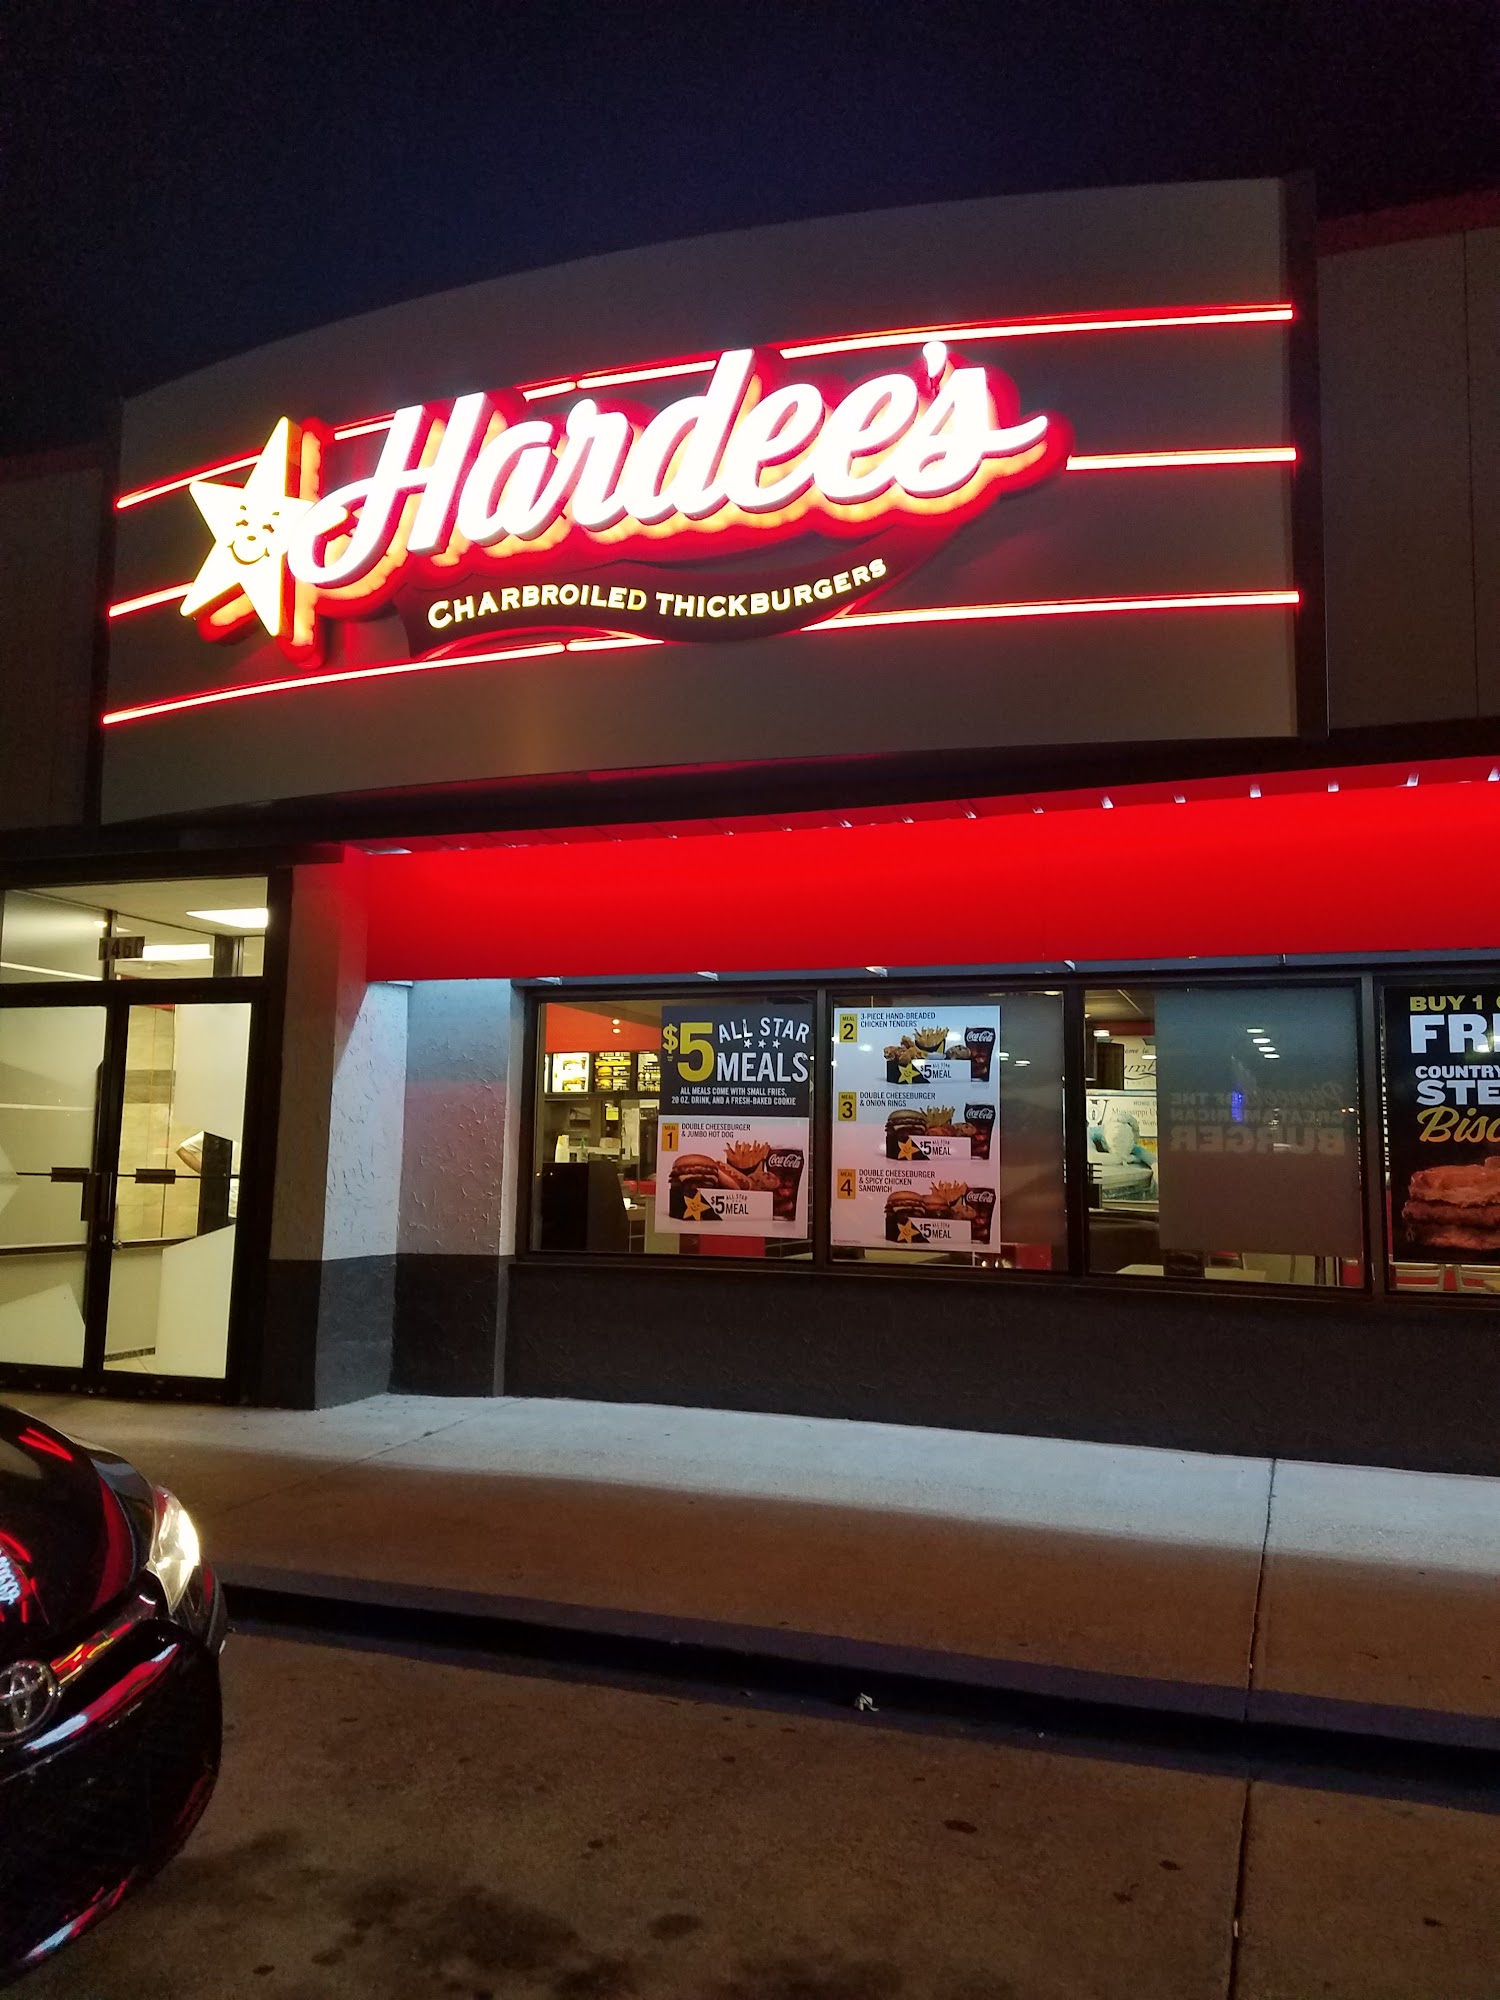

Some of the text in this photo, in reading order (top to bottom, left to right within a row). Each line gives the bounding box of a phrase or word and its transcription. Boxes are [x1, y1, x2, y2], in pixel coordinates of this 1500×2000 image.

[287, 342, 1047, 586] Hardee's
[427, 557, 888, 629] CHARBROILED THICKBURGERS
[1409, 995, 1465, 1012] BUY
[1472, 995, 1483, 1010] 1
[860, 1012, 935, 1020] 3-PIECE HAND-BREADED
[718, 1017, 810, 1044] ALL STAR
[843, 1023, 854, 1040] 2
[662, 1022, 714, 1082] $5
[717, 1052, 809, 1083] MEALS
[920, 1064, 931, 1079] $5
[932, 1070, 951, 1079] MEAL
[680, 1087, 787, 1097] ALL MEALS COME WITH SMALL FRIES,
[886, 1092, 935, 1100] CHEESEBURGER
[671, 1096, 680, 1104] 20
[691, 1096, 711, 1105] DRINK,
[712, 1097, 725, 1105] AND
[725, 1097, 730, 1105] A
[730, 1097, 772, 1105] FRESH-BAKED
[773, 1098, 796, 1106] COOKIE
[842, 1101, 853, 1119] 3
[681, 1123, 751, 1131] DOUBLE CHEESEBURGER
[667, 1132, 673, 1149] 1
[721, 1131, 734, 1139] DOG
[920, 1141, 931, 1156] $5
[932, 1146, 951, 1155] MEAL
[859, 1169, 935, 1178] DOUBLE CHEESEBURGER
[840, 1179, 852, 1196] 4
[859, 1185, 892, 1193] SANDWICH
[885, 1178, 912, 1186] CHICKEN
[710, 1195, 725, 1214] $5
[725, 1203, 749, 1215] MEAL
[920, 1224, 931, 1239] $5
[932, 1230, 951, 1239] MEAL
